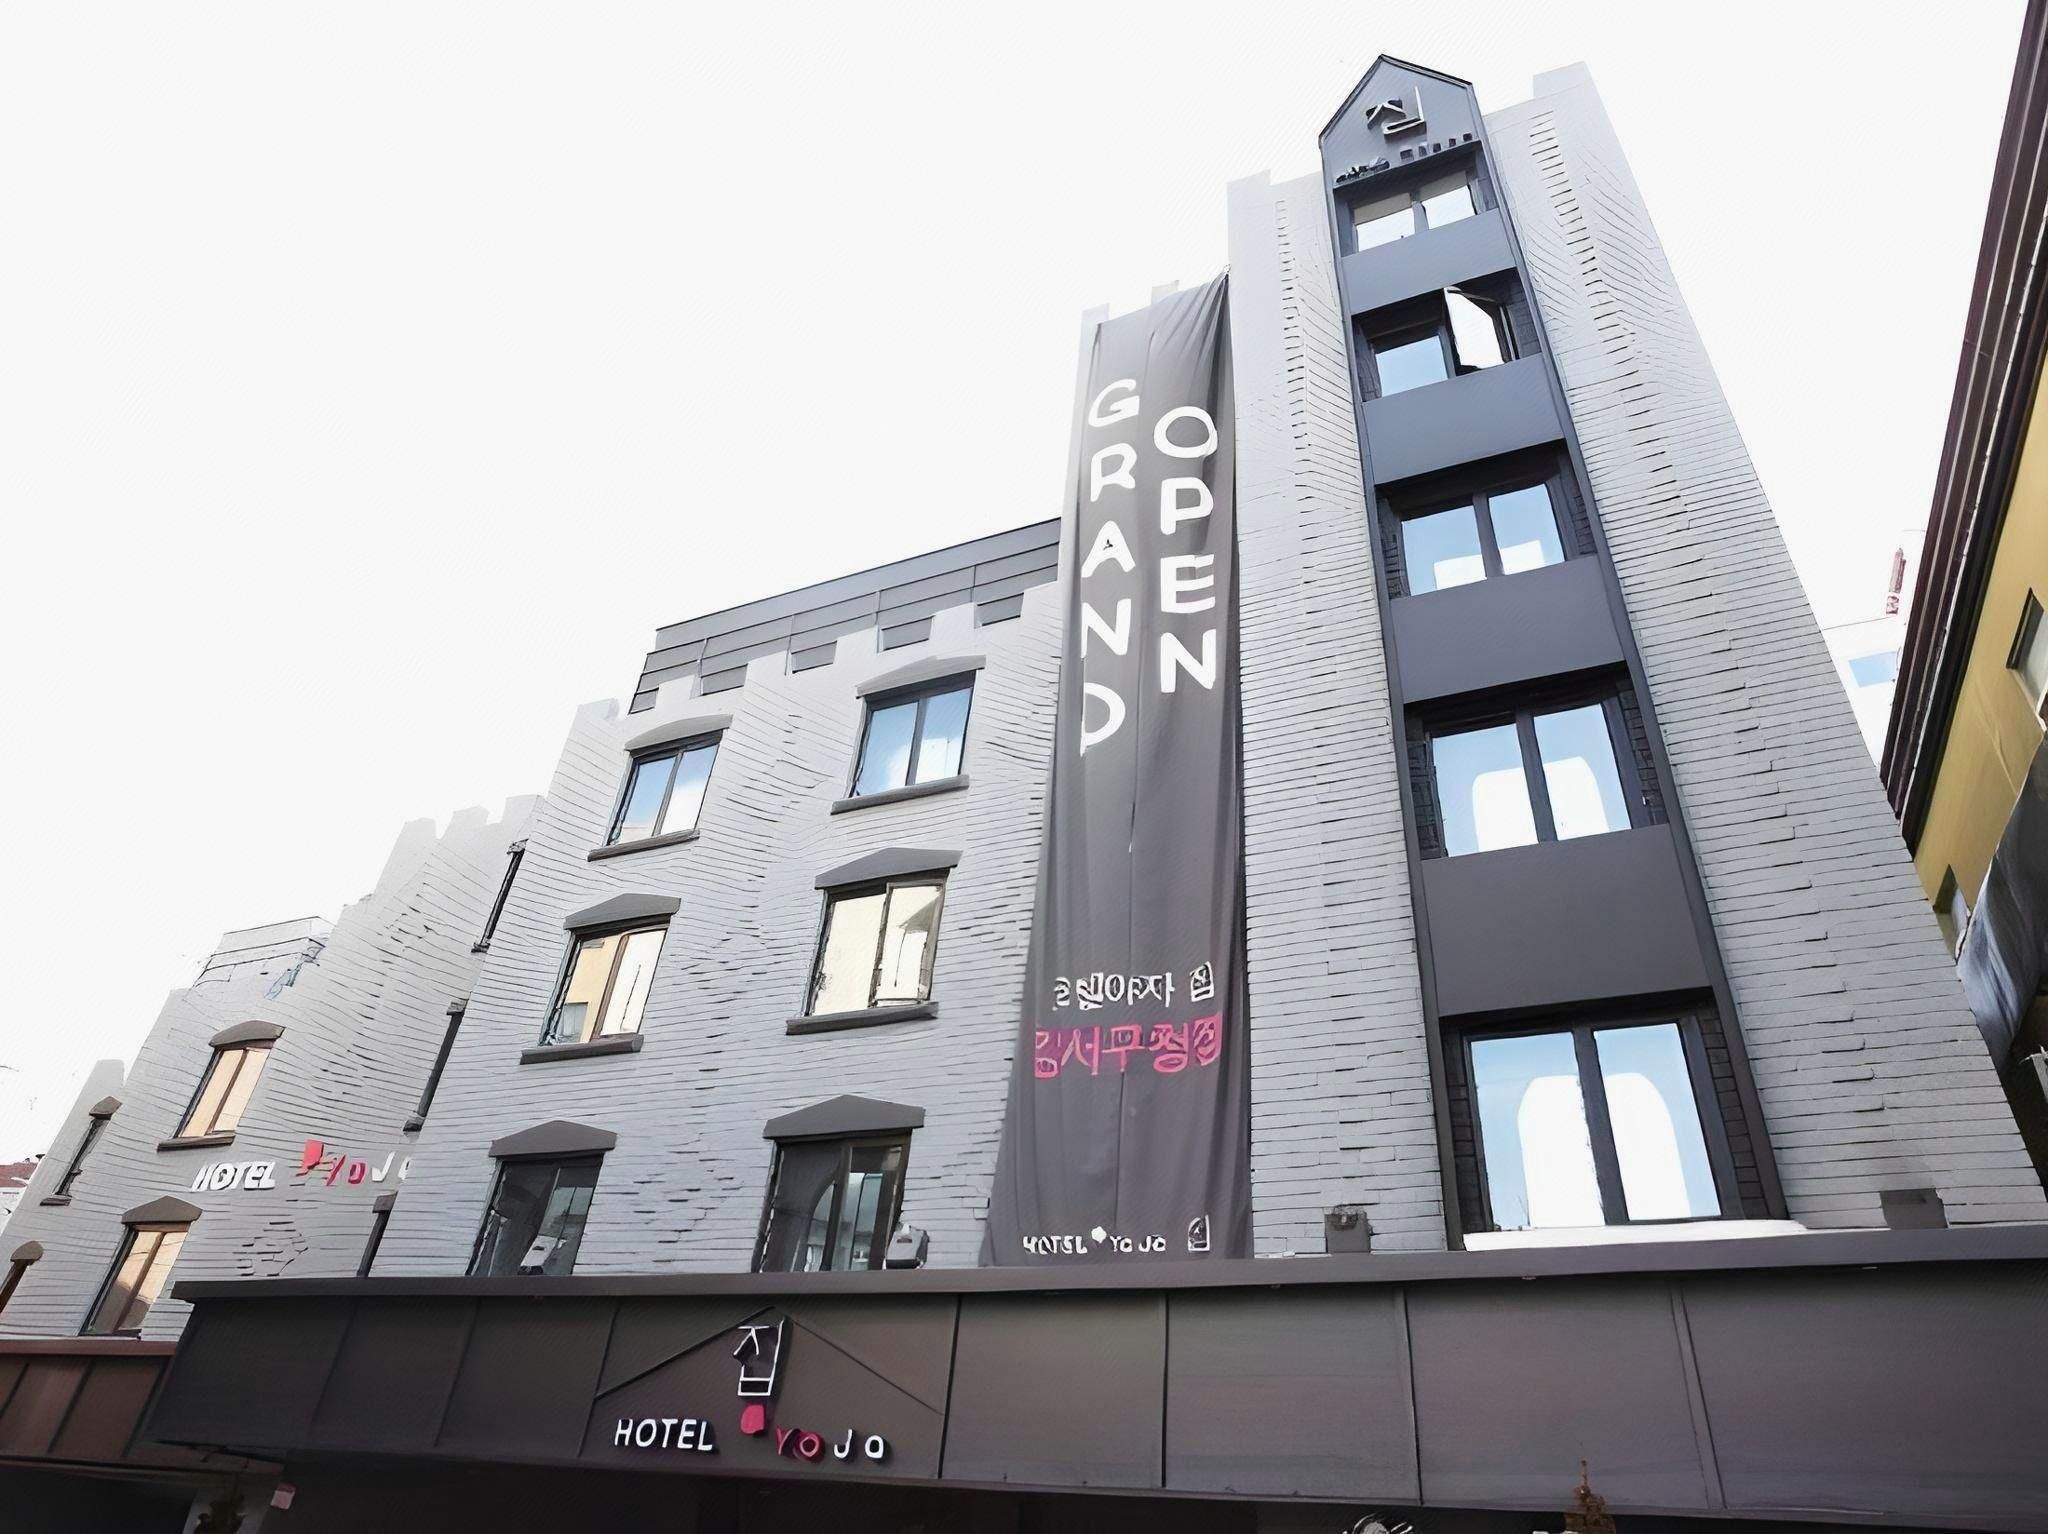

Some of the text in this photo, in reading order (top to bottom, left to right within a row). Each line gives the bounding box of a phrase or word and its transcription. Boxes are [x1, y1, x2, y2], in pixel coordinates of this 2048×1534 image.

[1153, 405, 1219, 693] OPEN
[1080, 378, 1140, 757] GRAND
[191, 1160, 277, 1193] HOTEL
[1022, 1235, 1088, 1255] HOTEL
[613, 1418, 714, 1452] HOTEL
